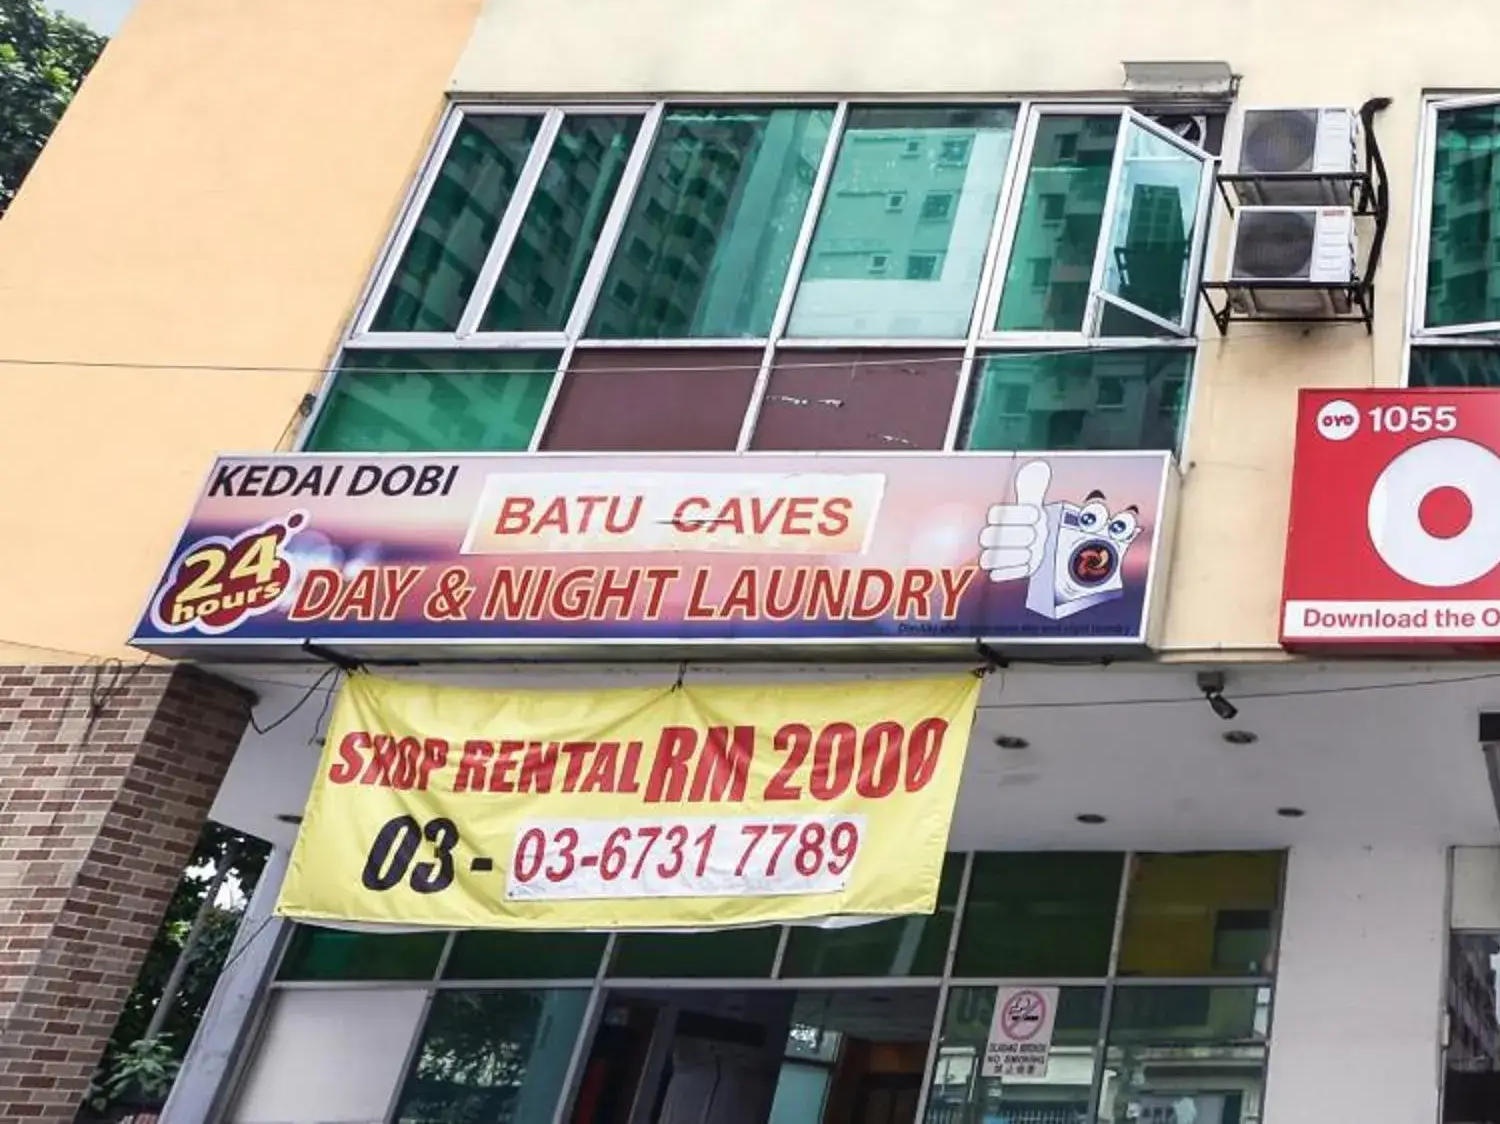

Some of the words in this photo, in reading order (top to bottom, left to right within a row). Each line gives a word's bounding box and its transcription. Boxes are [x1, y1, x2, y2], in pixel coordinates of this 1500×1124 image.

[1322, 414, 1355, 427] OYO
[1368, 406, 1457, 432] 1055
[207, 464, 343, 497] KEDAI
[346, 464, 460, 497] DOBI
[494, 496, 644, 536] BATU
[672, 496, 853, 537] CAVES
[175, 534, 281, 604] 24
[172, 582, 281, 624] hours
[288, 567, 424, 622] DAY
[424, 567, 476, 622] &
[482, 566, 681, 622] NIGHT
[684, 565, 979, 622] LAUNDRY
[1303, 608, 1428, 629] Download
[1434, 608, 1476, 629] the
[328, 731, 450, 792] SHOP
[453, 738, 641, 794] RENTAL
[643, 725, 756, 804] RM
[763, 718, 949, 802] 2000
[732, 820, 860, 878] 7789
